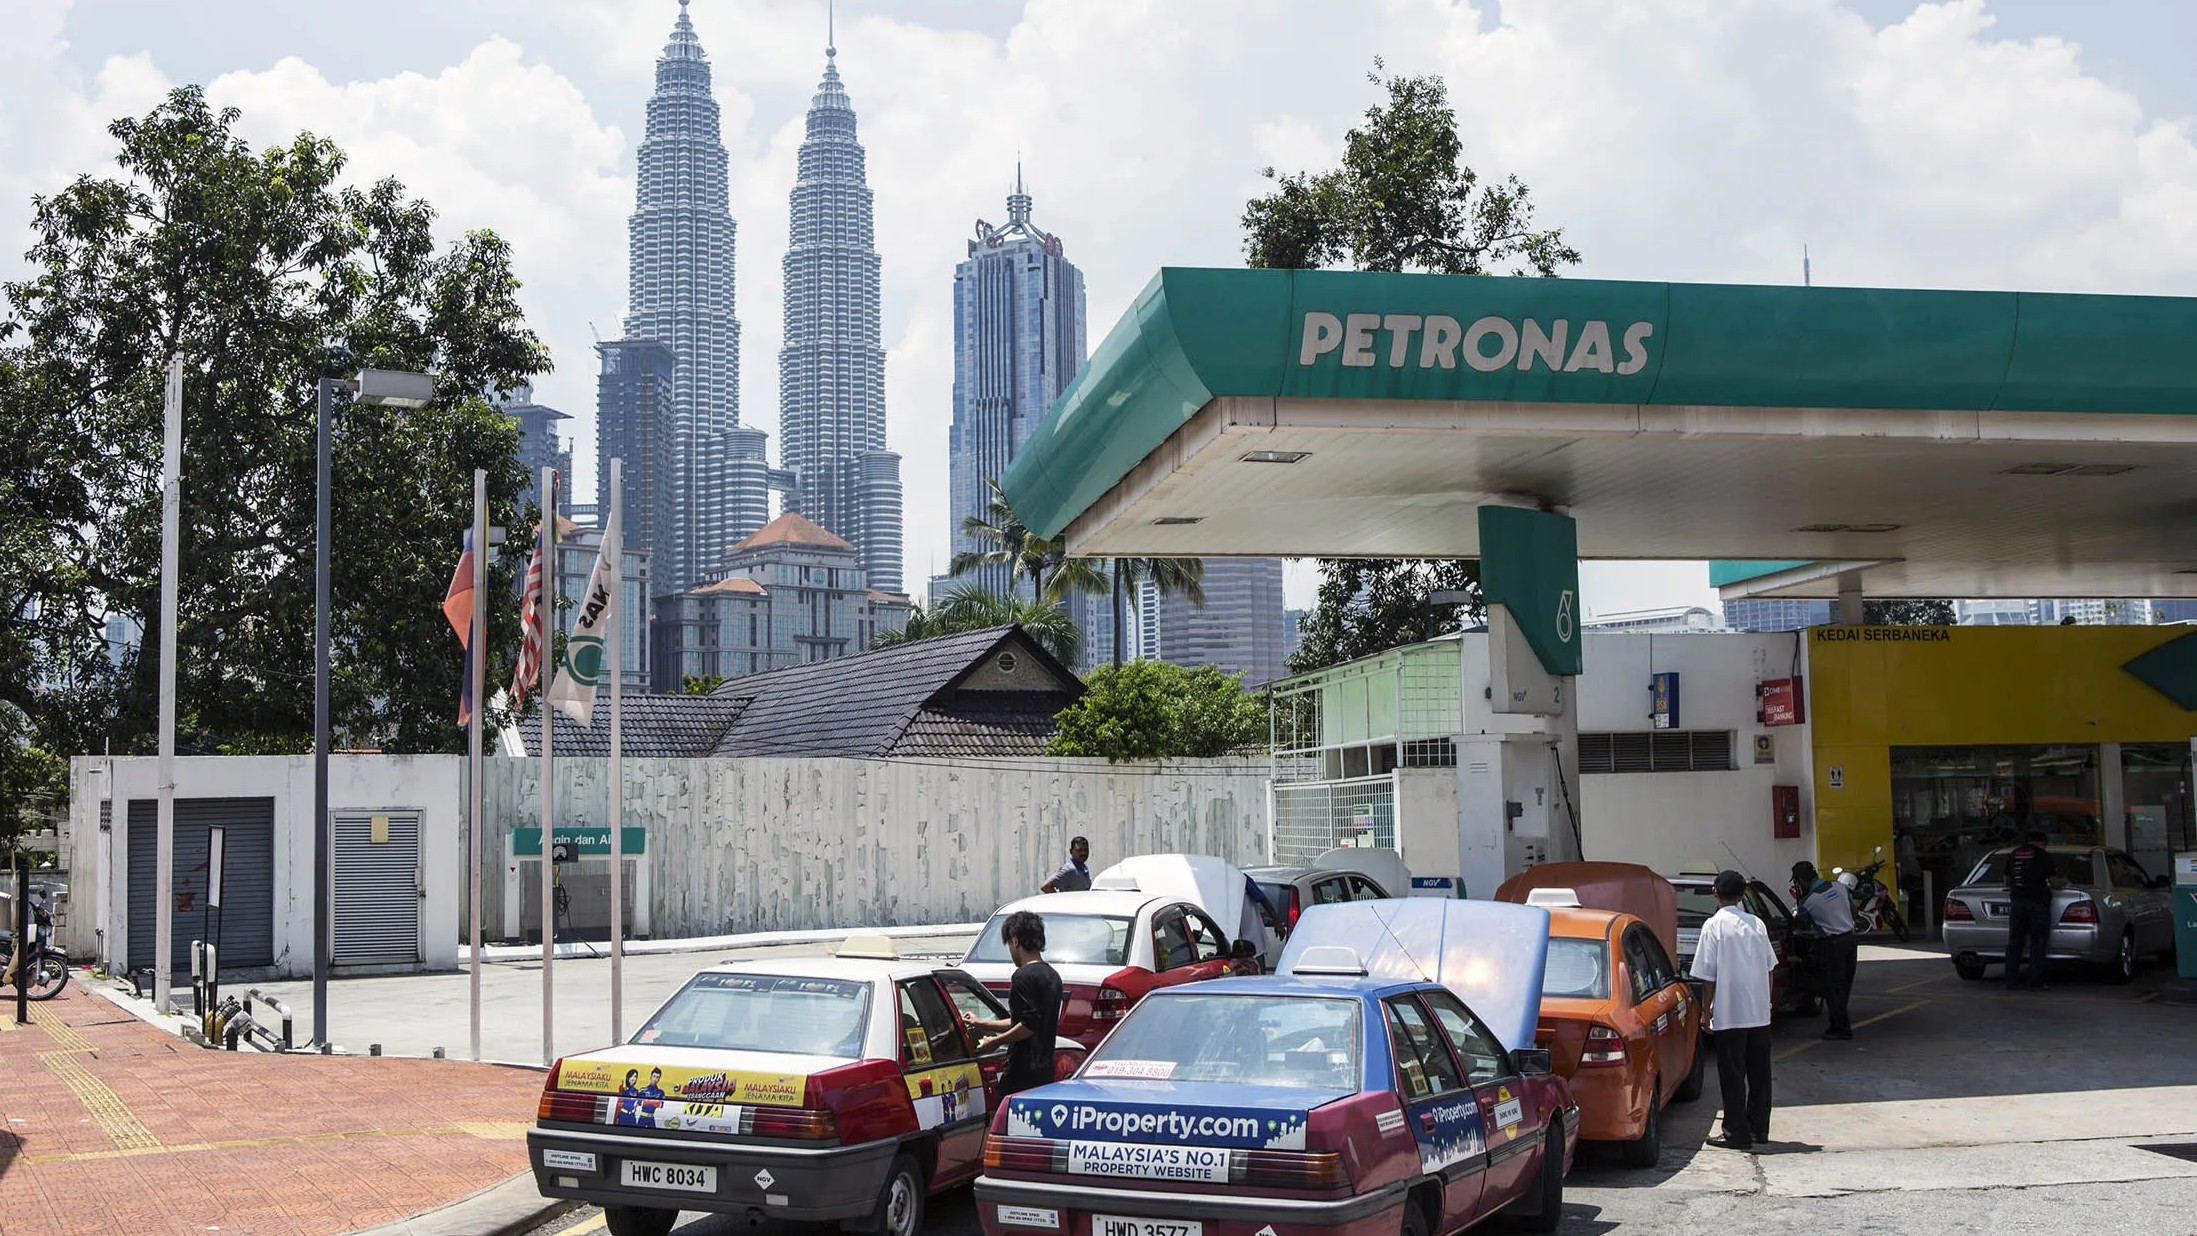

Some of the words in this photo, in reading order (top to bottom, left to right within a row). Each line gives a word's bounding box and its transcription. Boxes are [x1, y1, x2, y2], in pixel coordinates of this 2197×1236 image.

[1299, 311, 1654, 375] PETRONAS
[1817, 629, 1860, 641] KEDAI
[1864, 629, 1950, 641] SERBANEKA
[1554, 685, 1561, 704] 2
[574, 834, 595, 845] dan
[1422, 878, 1441, 888] NGV
[565, 1071, 612, 1082] MALAYSIAKU
[688, 1071, 726, 1085] PRODUK
[564, 1080, 593, 1088] JENAMA
[595, 1081, 609, 1089] KITA
[681, 1078, 737, 1096] MALAYSIA
[743, 1082, 796, 1095] MALAYSIAKU
[685, 1091, 726, 1100] KEBANGGAAN
[743, 1092, 777, 1102] JENAMA
[778, 1094, 795, 1103] KITA
[682, 1101, 724, 1118] KITA
[1437, 1100, 1479, 1124] iProperty.com
[1071, 1105, 1259, 1140] iProperty.com
[1185, 1152, 1226, 1168] NO.1
[632, 1164, 661, 1183] HWC
[666, 1167, 705, 1187] 8034
[1083, 1161, 1150, 1177] PROPERTY
[1154, 1164, 1213, 1180] WEBSITE
[757, 1175, 771, 1183] NGV
[1105, 1221, 1138, 1236] HWD
[1144, 1224, 1189, 1236] 3577
